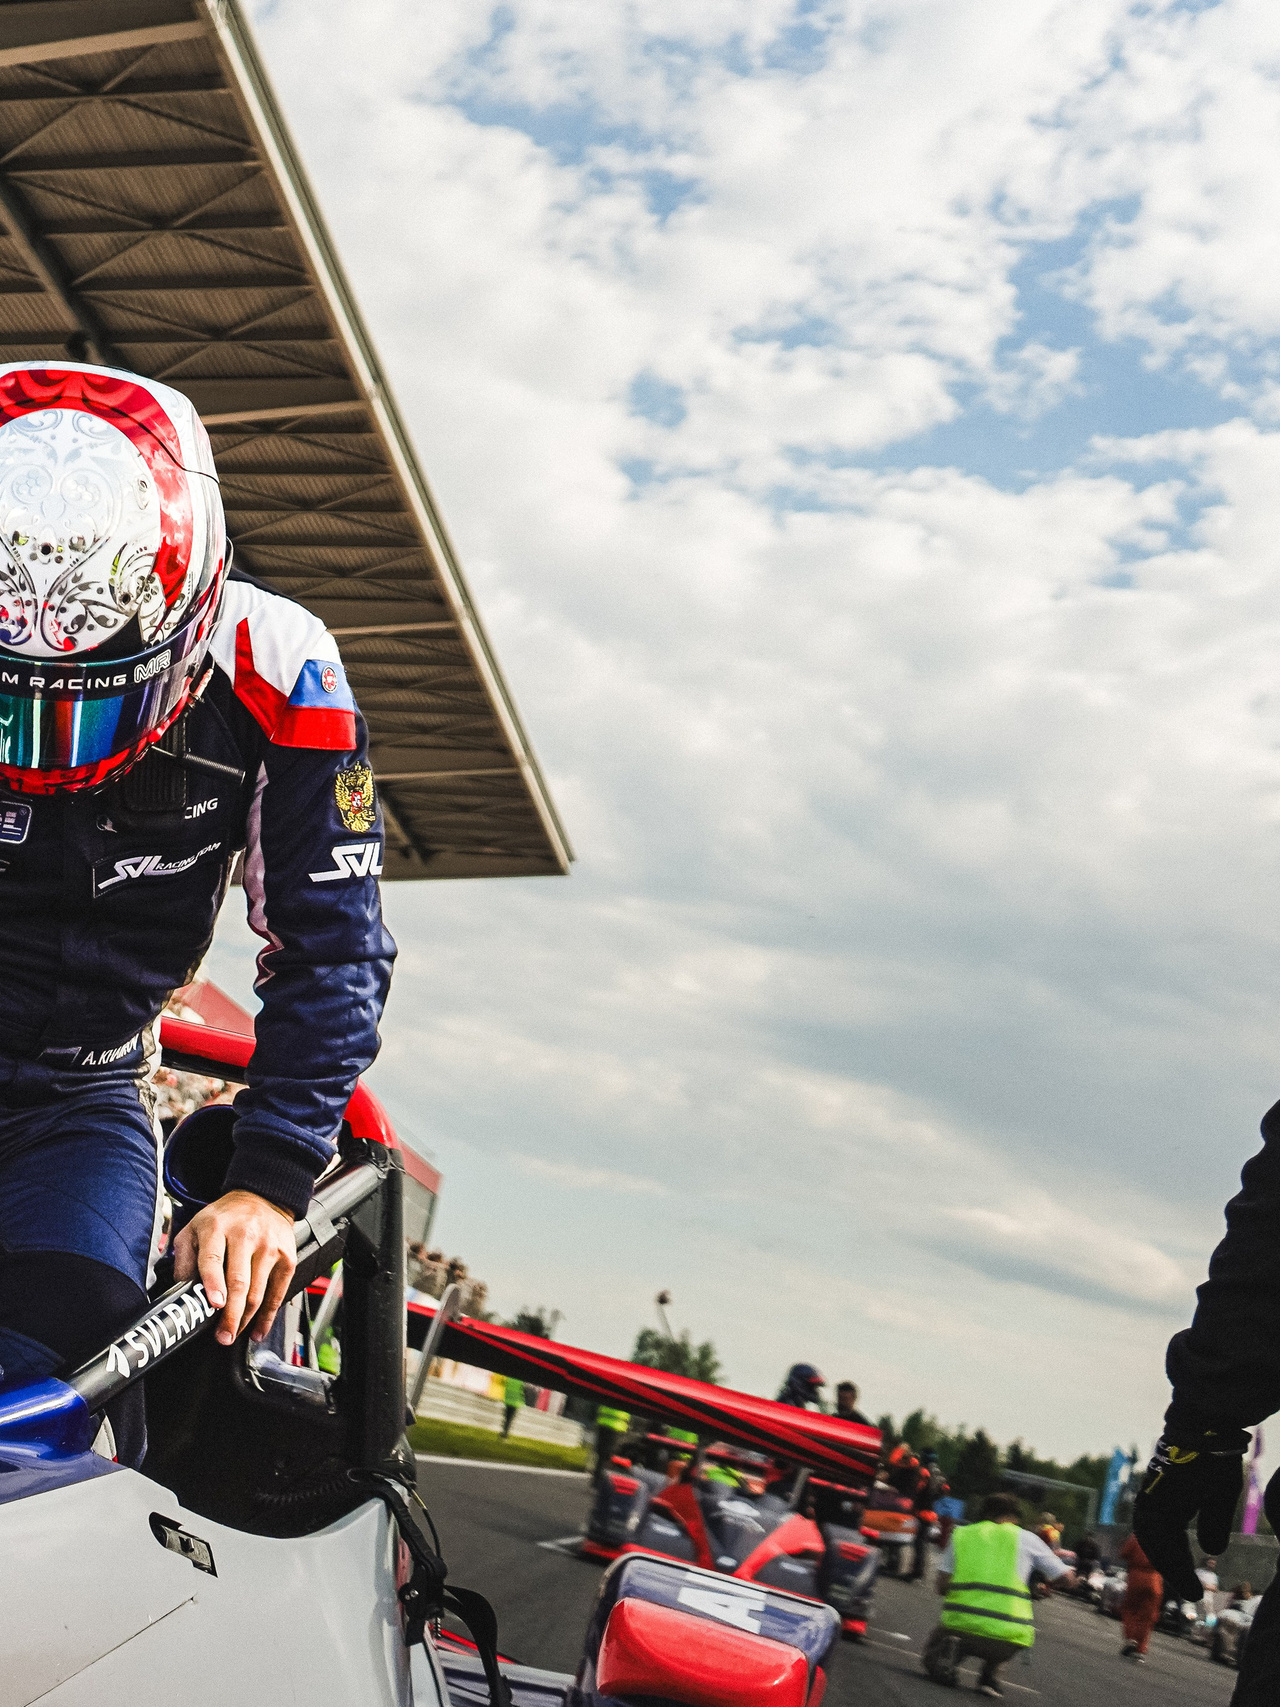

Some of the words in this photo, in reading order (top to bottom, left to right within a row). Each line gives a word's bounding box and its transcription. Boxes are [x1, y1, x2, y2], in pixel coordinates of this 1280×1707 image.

[29, 673, 127, 690] RACING
[134, 649, 172, 683] MR
[123, 1282, 219, 1368] SVLRAC
